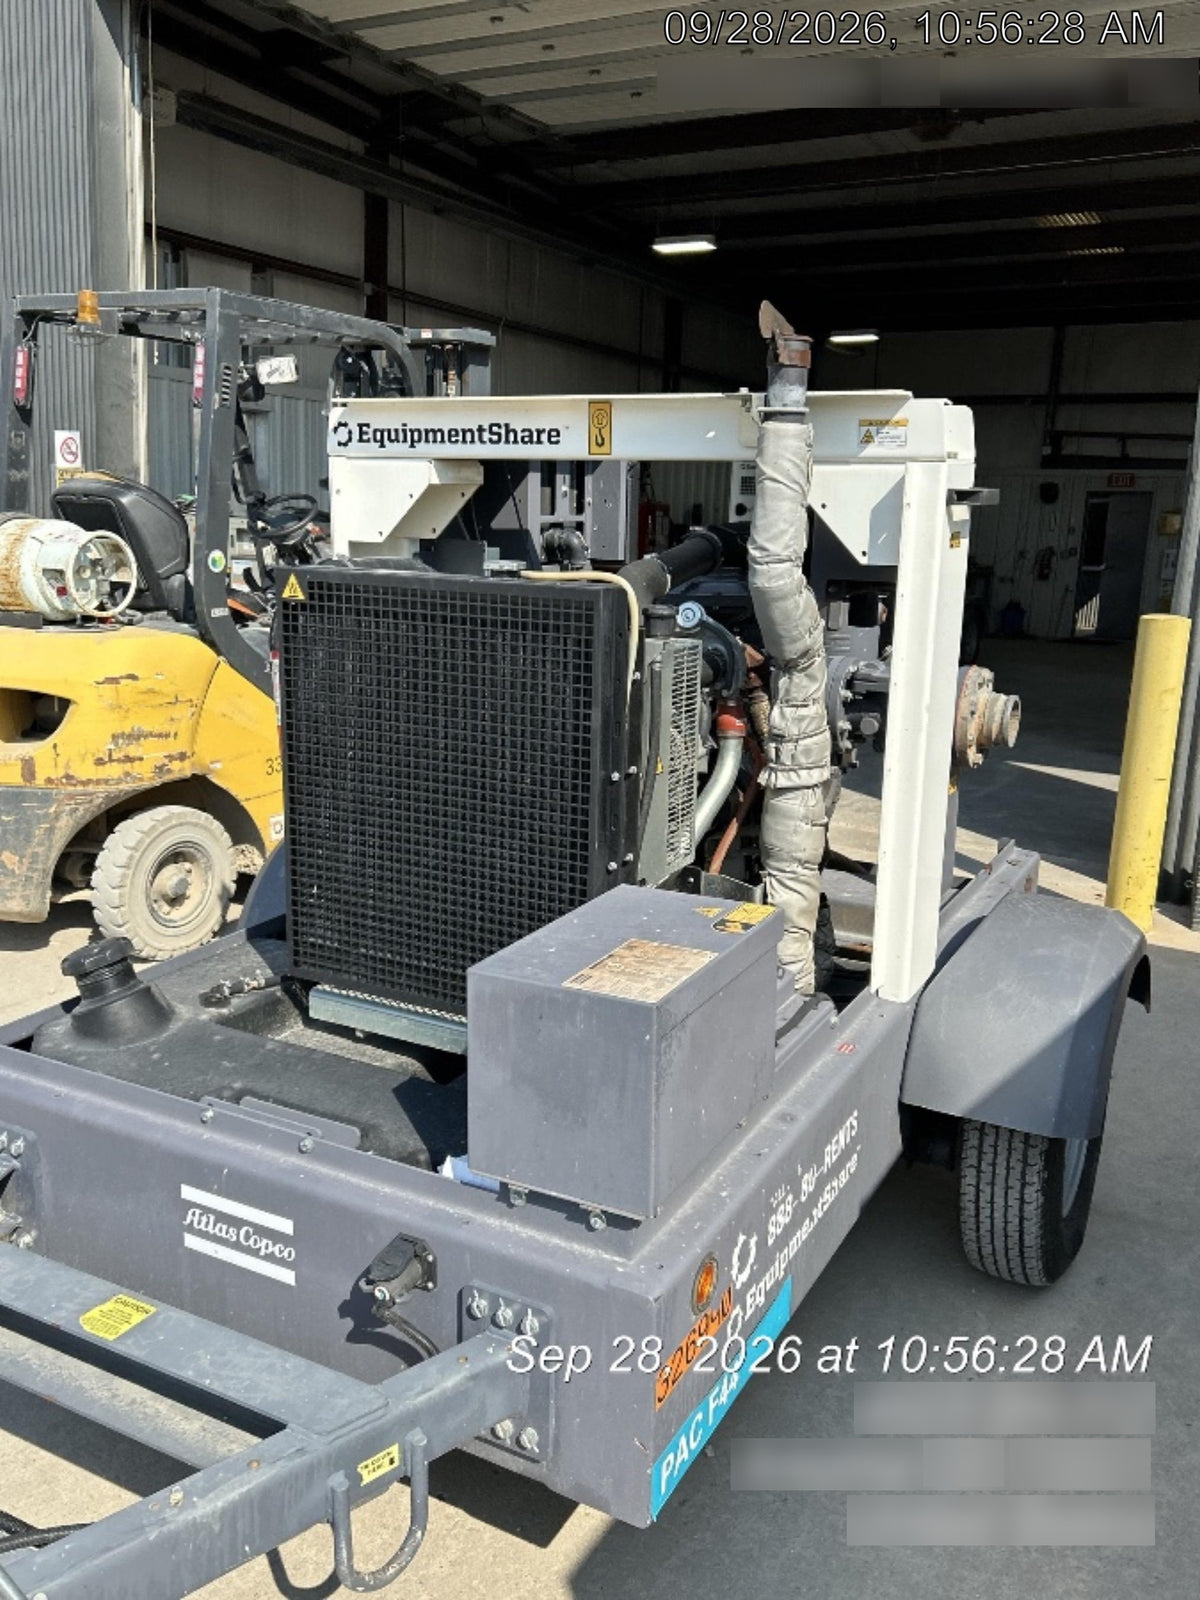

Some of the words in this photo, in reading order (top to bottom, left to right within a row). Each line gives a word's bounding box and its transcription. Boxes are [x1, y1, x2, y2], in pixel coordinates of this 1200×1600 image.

[356, 422, 561, 448] EquipmentShare
[182, 1208, 238, 1242] Atlas
[239, 1225, 296, 1262] Copco
[660, 1411, 704, 1496] PAC
